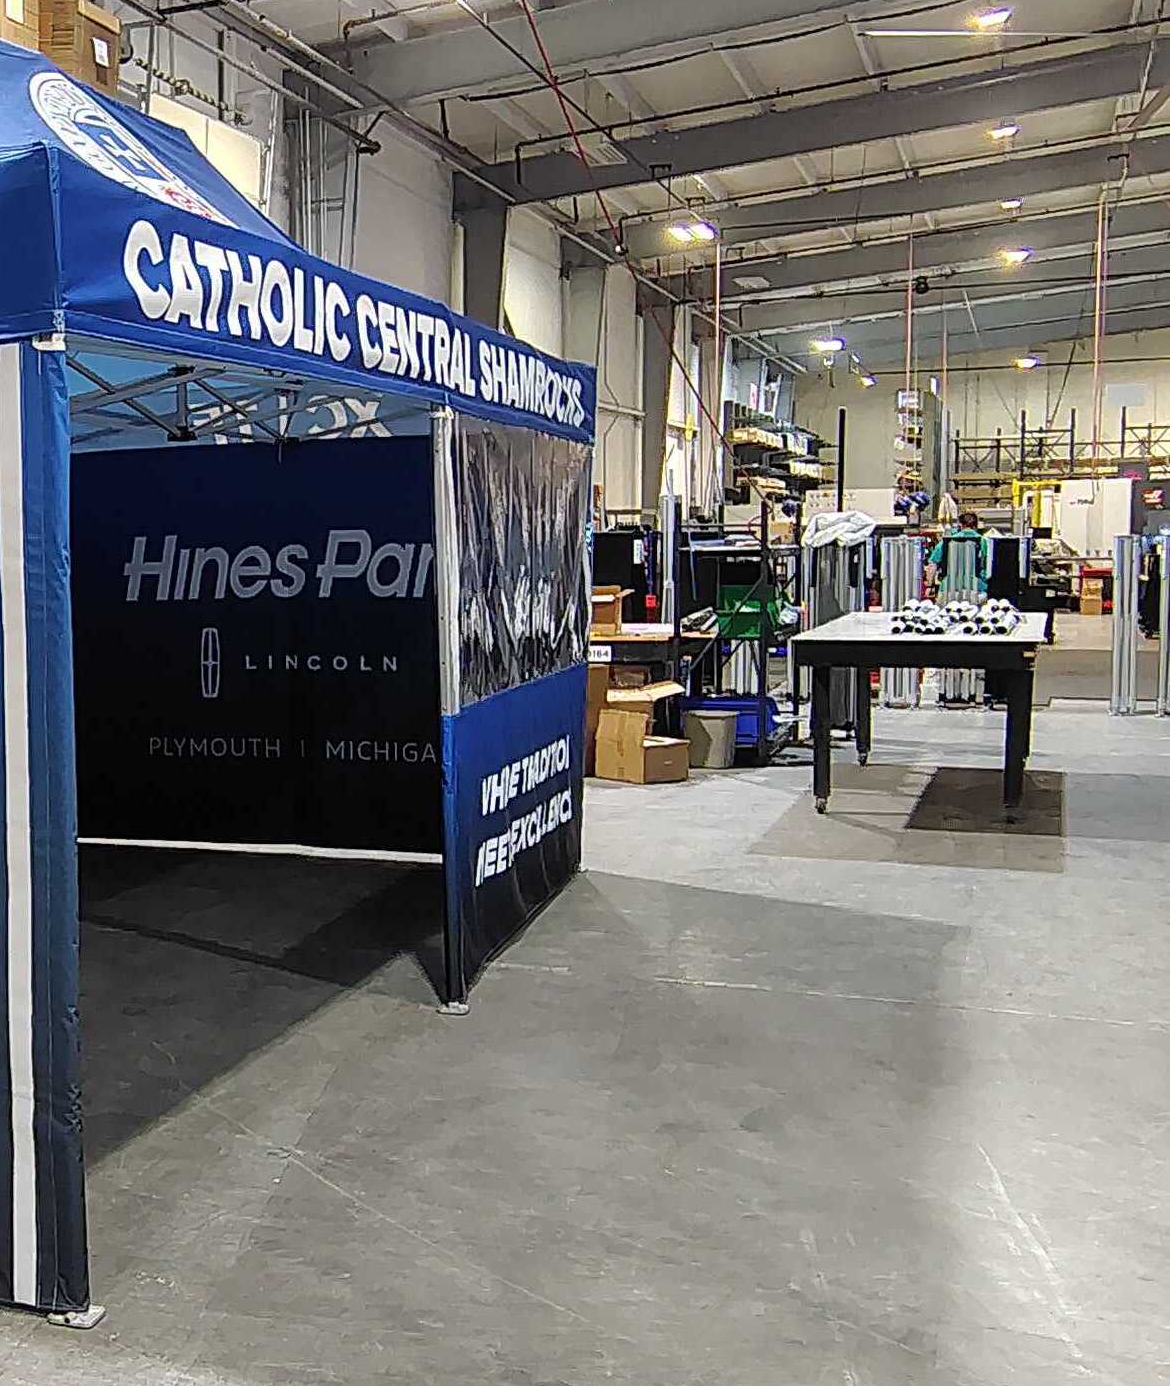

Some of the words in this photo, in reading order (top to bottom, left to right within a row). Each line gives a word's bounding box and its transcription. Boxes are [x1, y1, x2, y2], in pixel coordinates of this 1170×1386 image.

[123, 219, 352, 362] CATHOLIC
[356, 294, 476, 397] CENTRAL
[479, 339, 585, 429] SHAMROCKS
[124, 534, 309, 602] Hines
[316, 529, 434, 598] Par
[245, 655, 398, 672] LINCOLN
[149, 736, 281, 758] PLYMOUTH
[325, 739, 437, 763] MICHIGA
